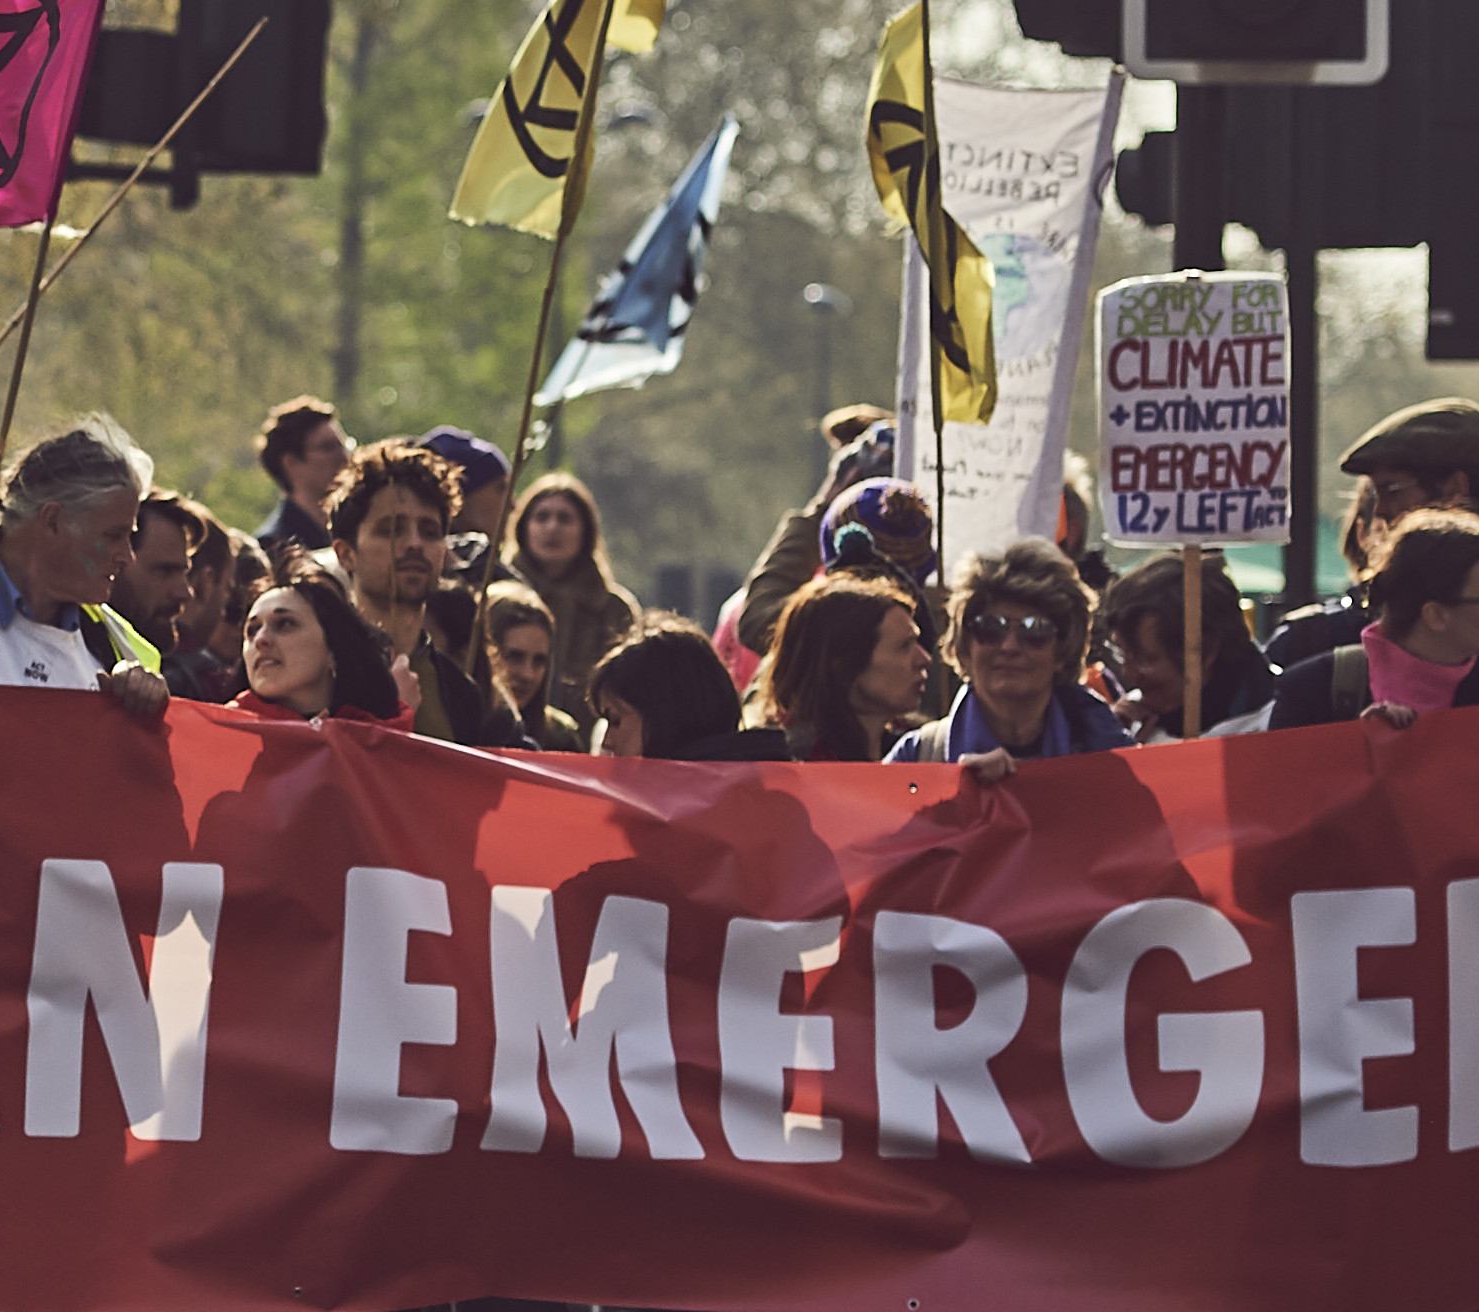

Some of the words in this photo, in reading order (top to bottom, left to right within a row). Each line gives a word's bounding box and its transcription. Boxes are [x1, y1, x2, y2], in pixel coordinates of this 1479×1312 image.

[1120, 285, 1214, 312] SORRY
[1232, 284, 1279, 308] FOR
[1117, 311, 1223, 338] DELAY
[1232, 311, 1284, 334] BUT
[1108, 335, 1285, 391] CLIMATE
[1134, 394, 1286, 433] EXTINCTION
[1111, 440, 1286, 492] EMERGENCY
[1176, 490, 1261, 534] LEFT
